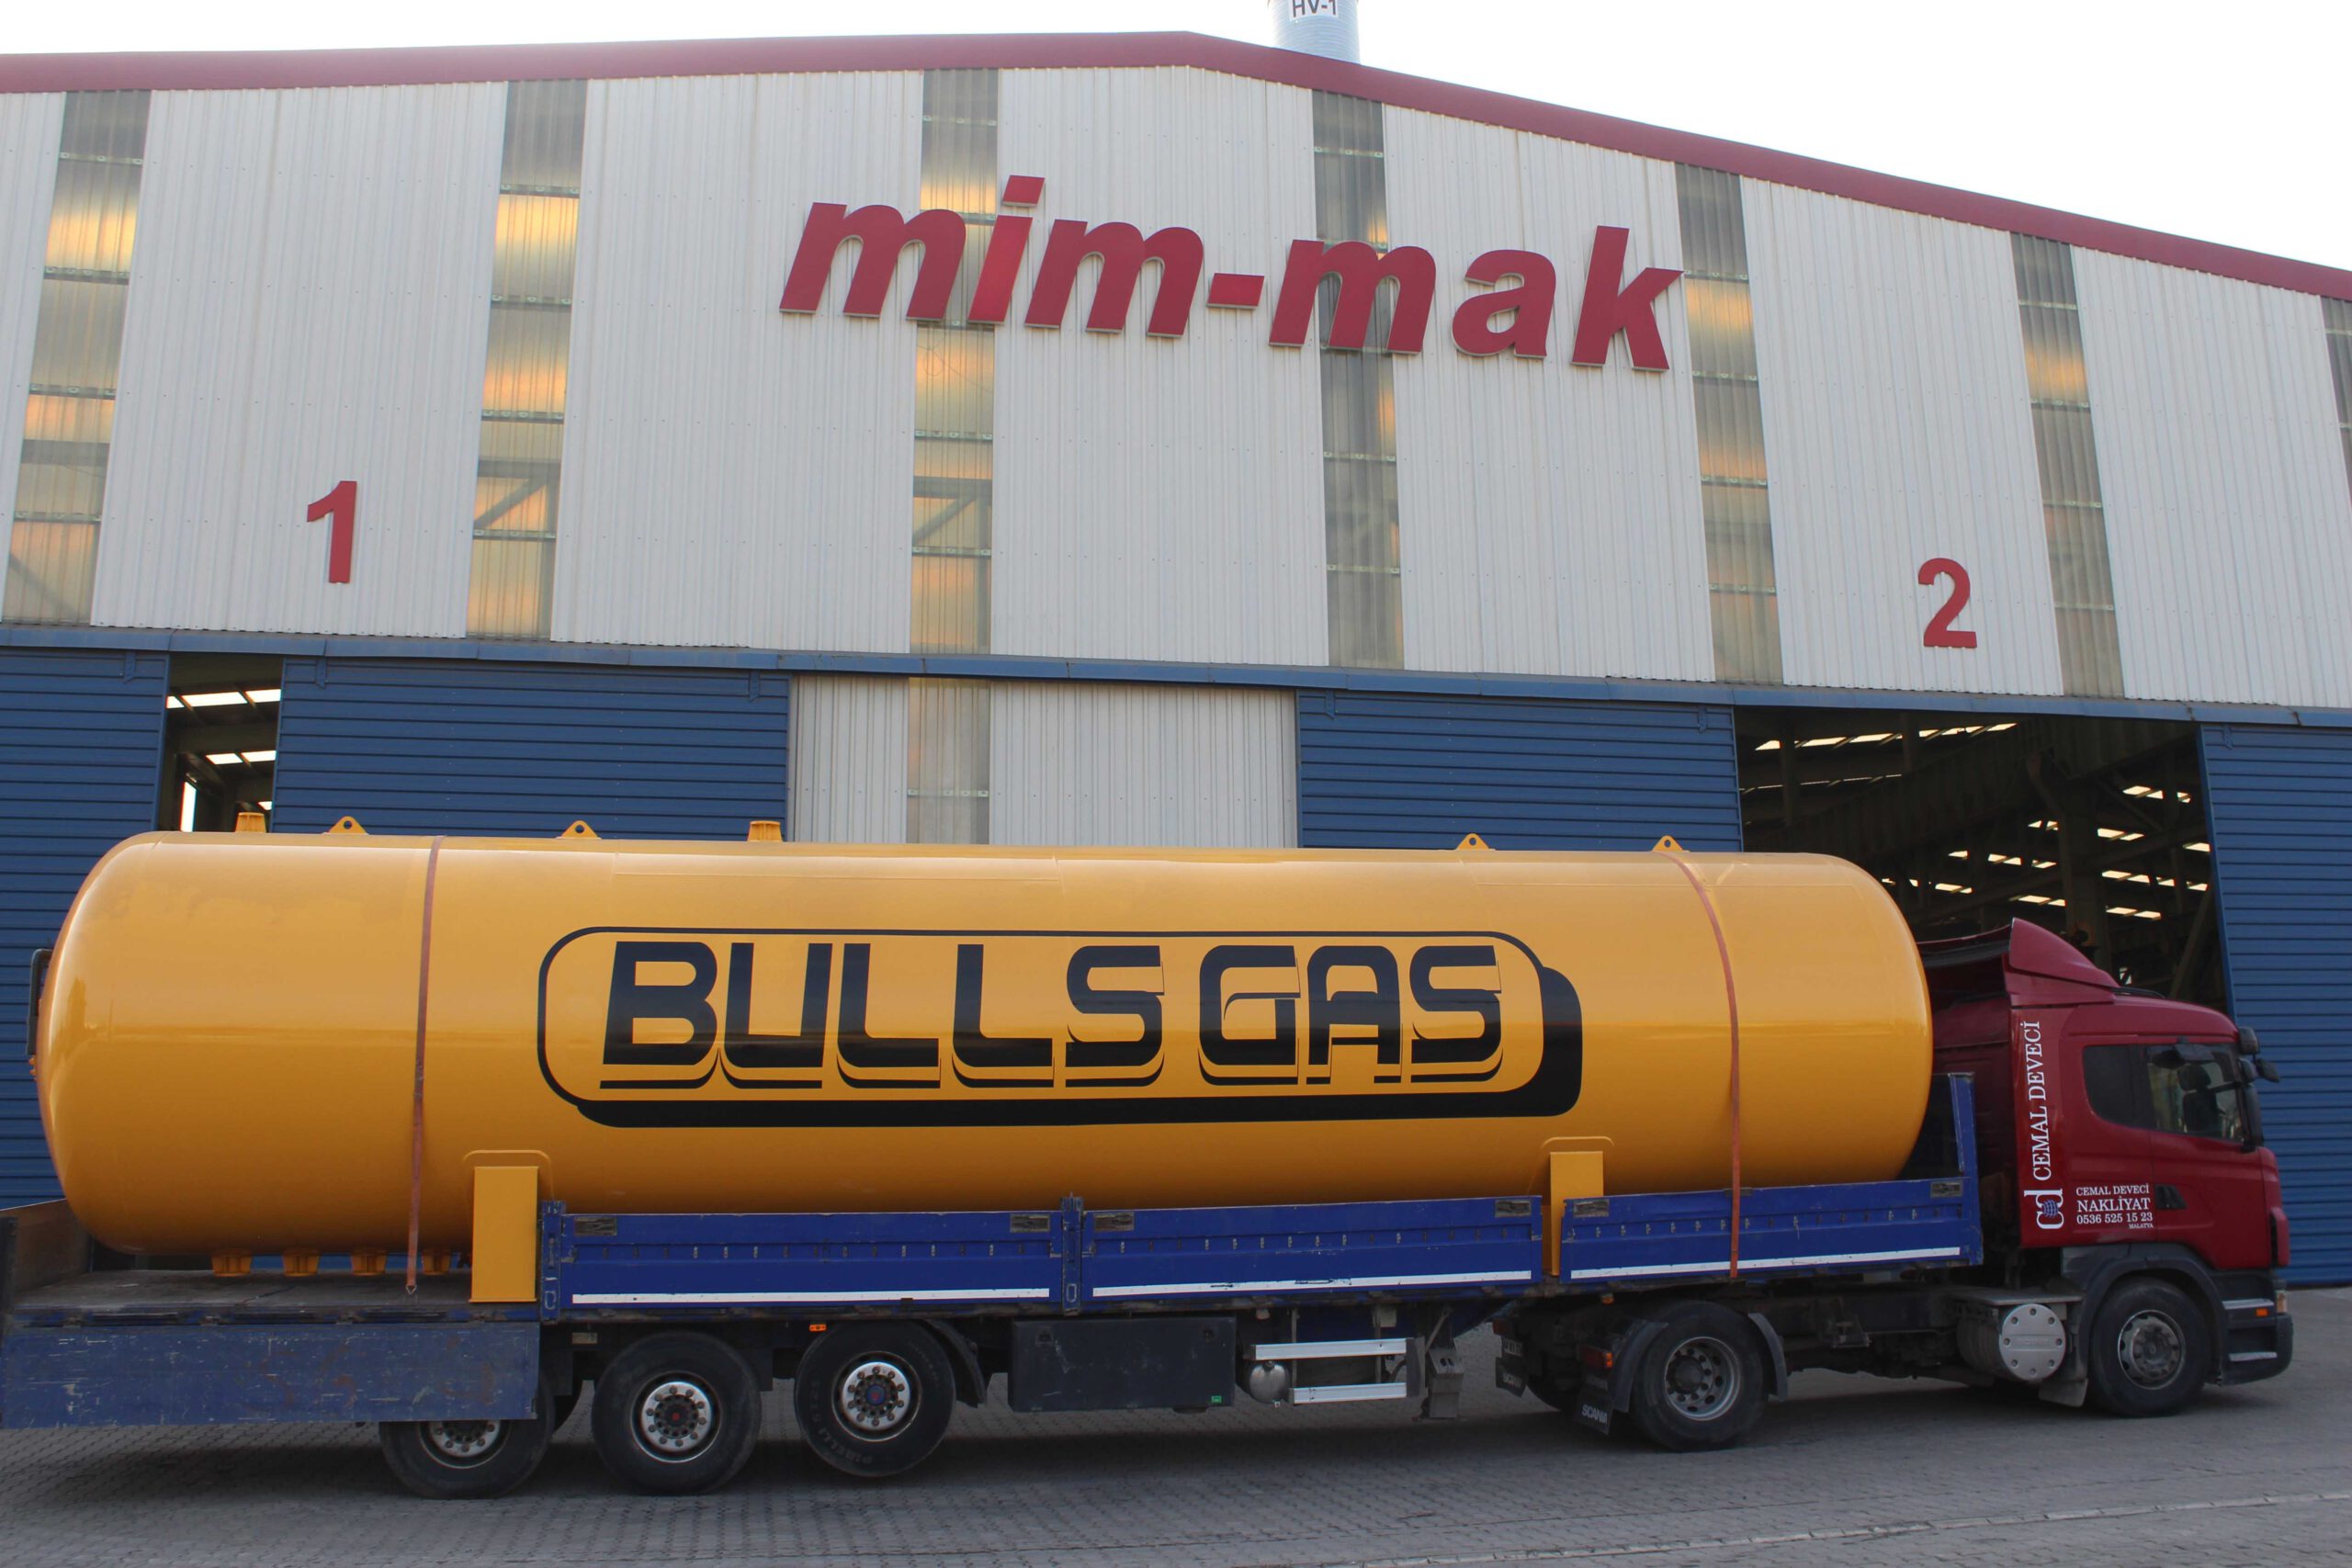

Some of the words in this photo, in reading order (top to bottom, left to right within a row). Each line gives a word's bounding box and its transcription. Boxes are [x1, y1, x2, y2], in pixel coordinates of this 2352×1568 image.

[1292, 0, 1336, 17] HV-1
[779, 175, 1685, 371] mim-mak
[307, 480, 357, 583] 1
[1917, 558, 1977, 649] 2
[2020, 1021, 2046, 1100] DEVECİ
[2030, 1106, 2052, 1181] CEMAL
[2076, 1187, 2111, 1196] CEMAL
[2113, 1183, 2150, 1195] DEVECİ
[2077, 1196, 2151, 1213] NAKLİYAT
[2076, 1214, 2102, 1224] 0536
[2105, 1213, 2123, 1224] 525
[2126, 1213, 2139, 1223] 15
[2141, 1212, 2154, 1222] 23
[1581, 1404, 1608, 1425] SCANIA
